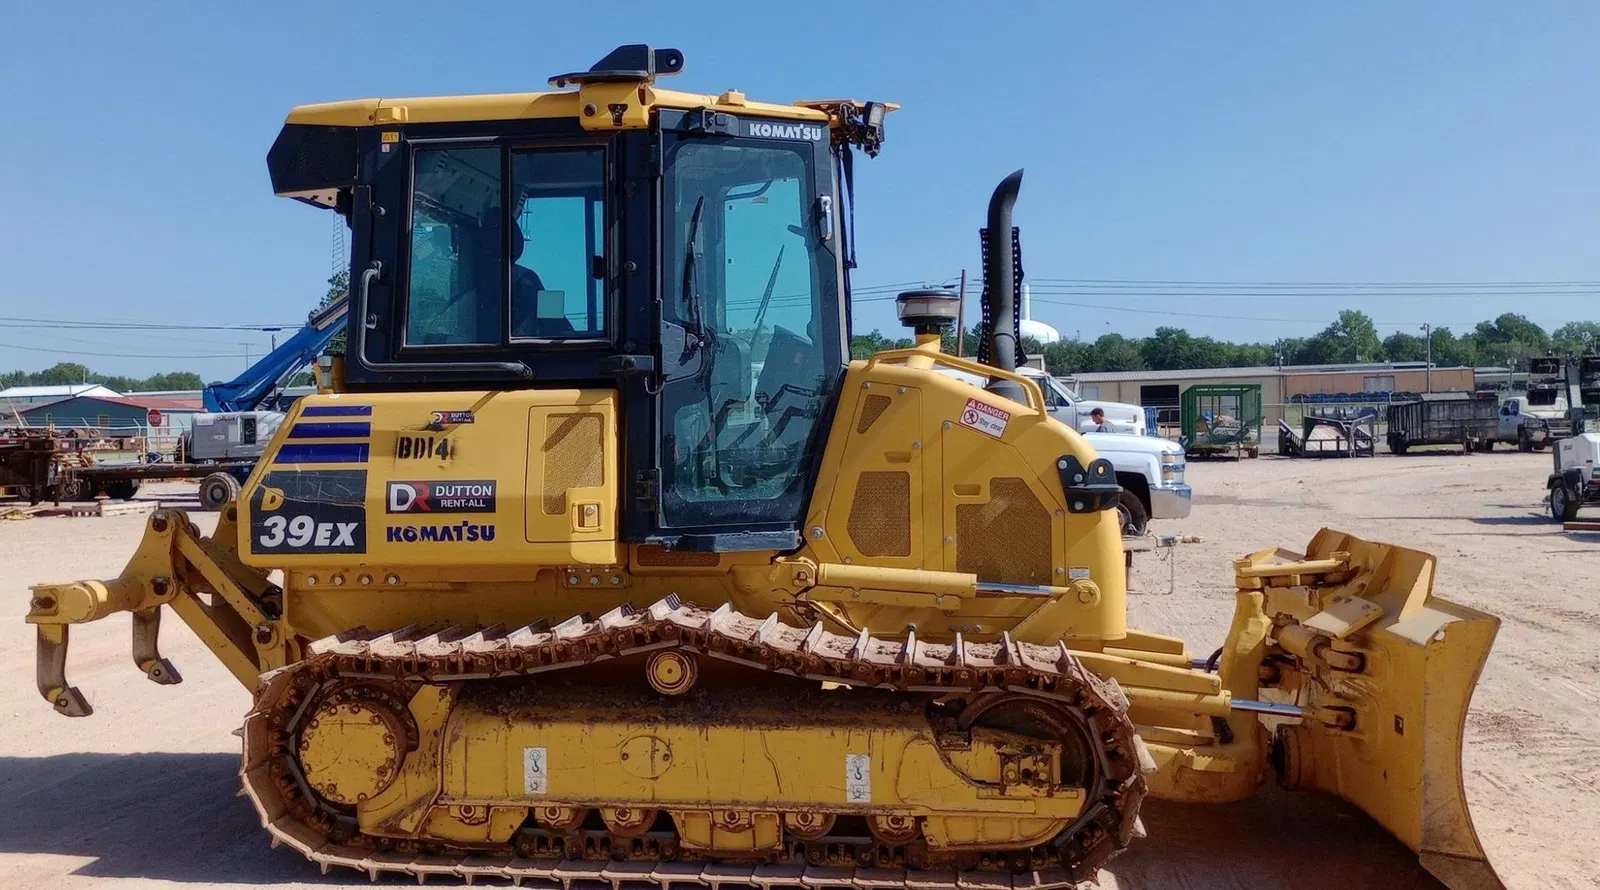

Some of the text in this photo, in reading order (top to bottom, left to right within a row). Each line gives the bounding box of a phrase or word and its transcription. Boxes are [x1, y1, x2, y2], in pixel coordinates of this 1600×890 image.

[749, 123, 822, 140] KOMATSU
[976, 403, 1010, 420] DANGER
[261, 487, 285, 511] D
[435, 485, 492, 497] DUTTON
[440, 499, 486, 508] RENT-ALL
[259, 515, 359, 548] 39EX
[386, 520, 496, 543] KOMATSU
